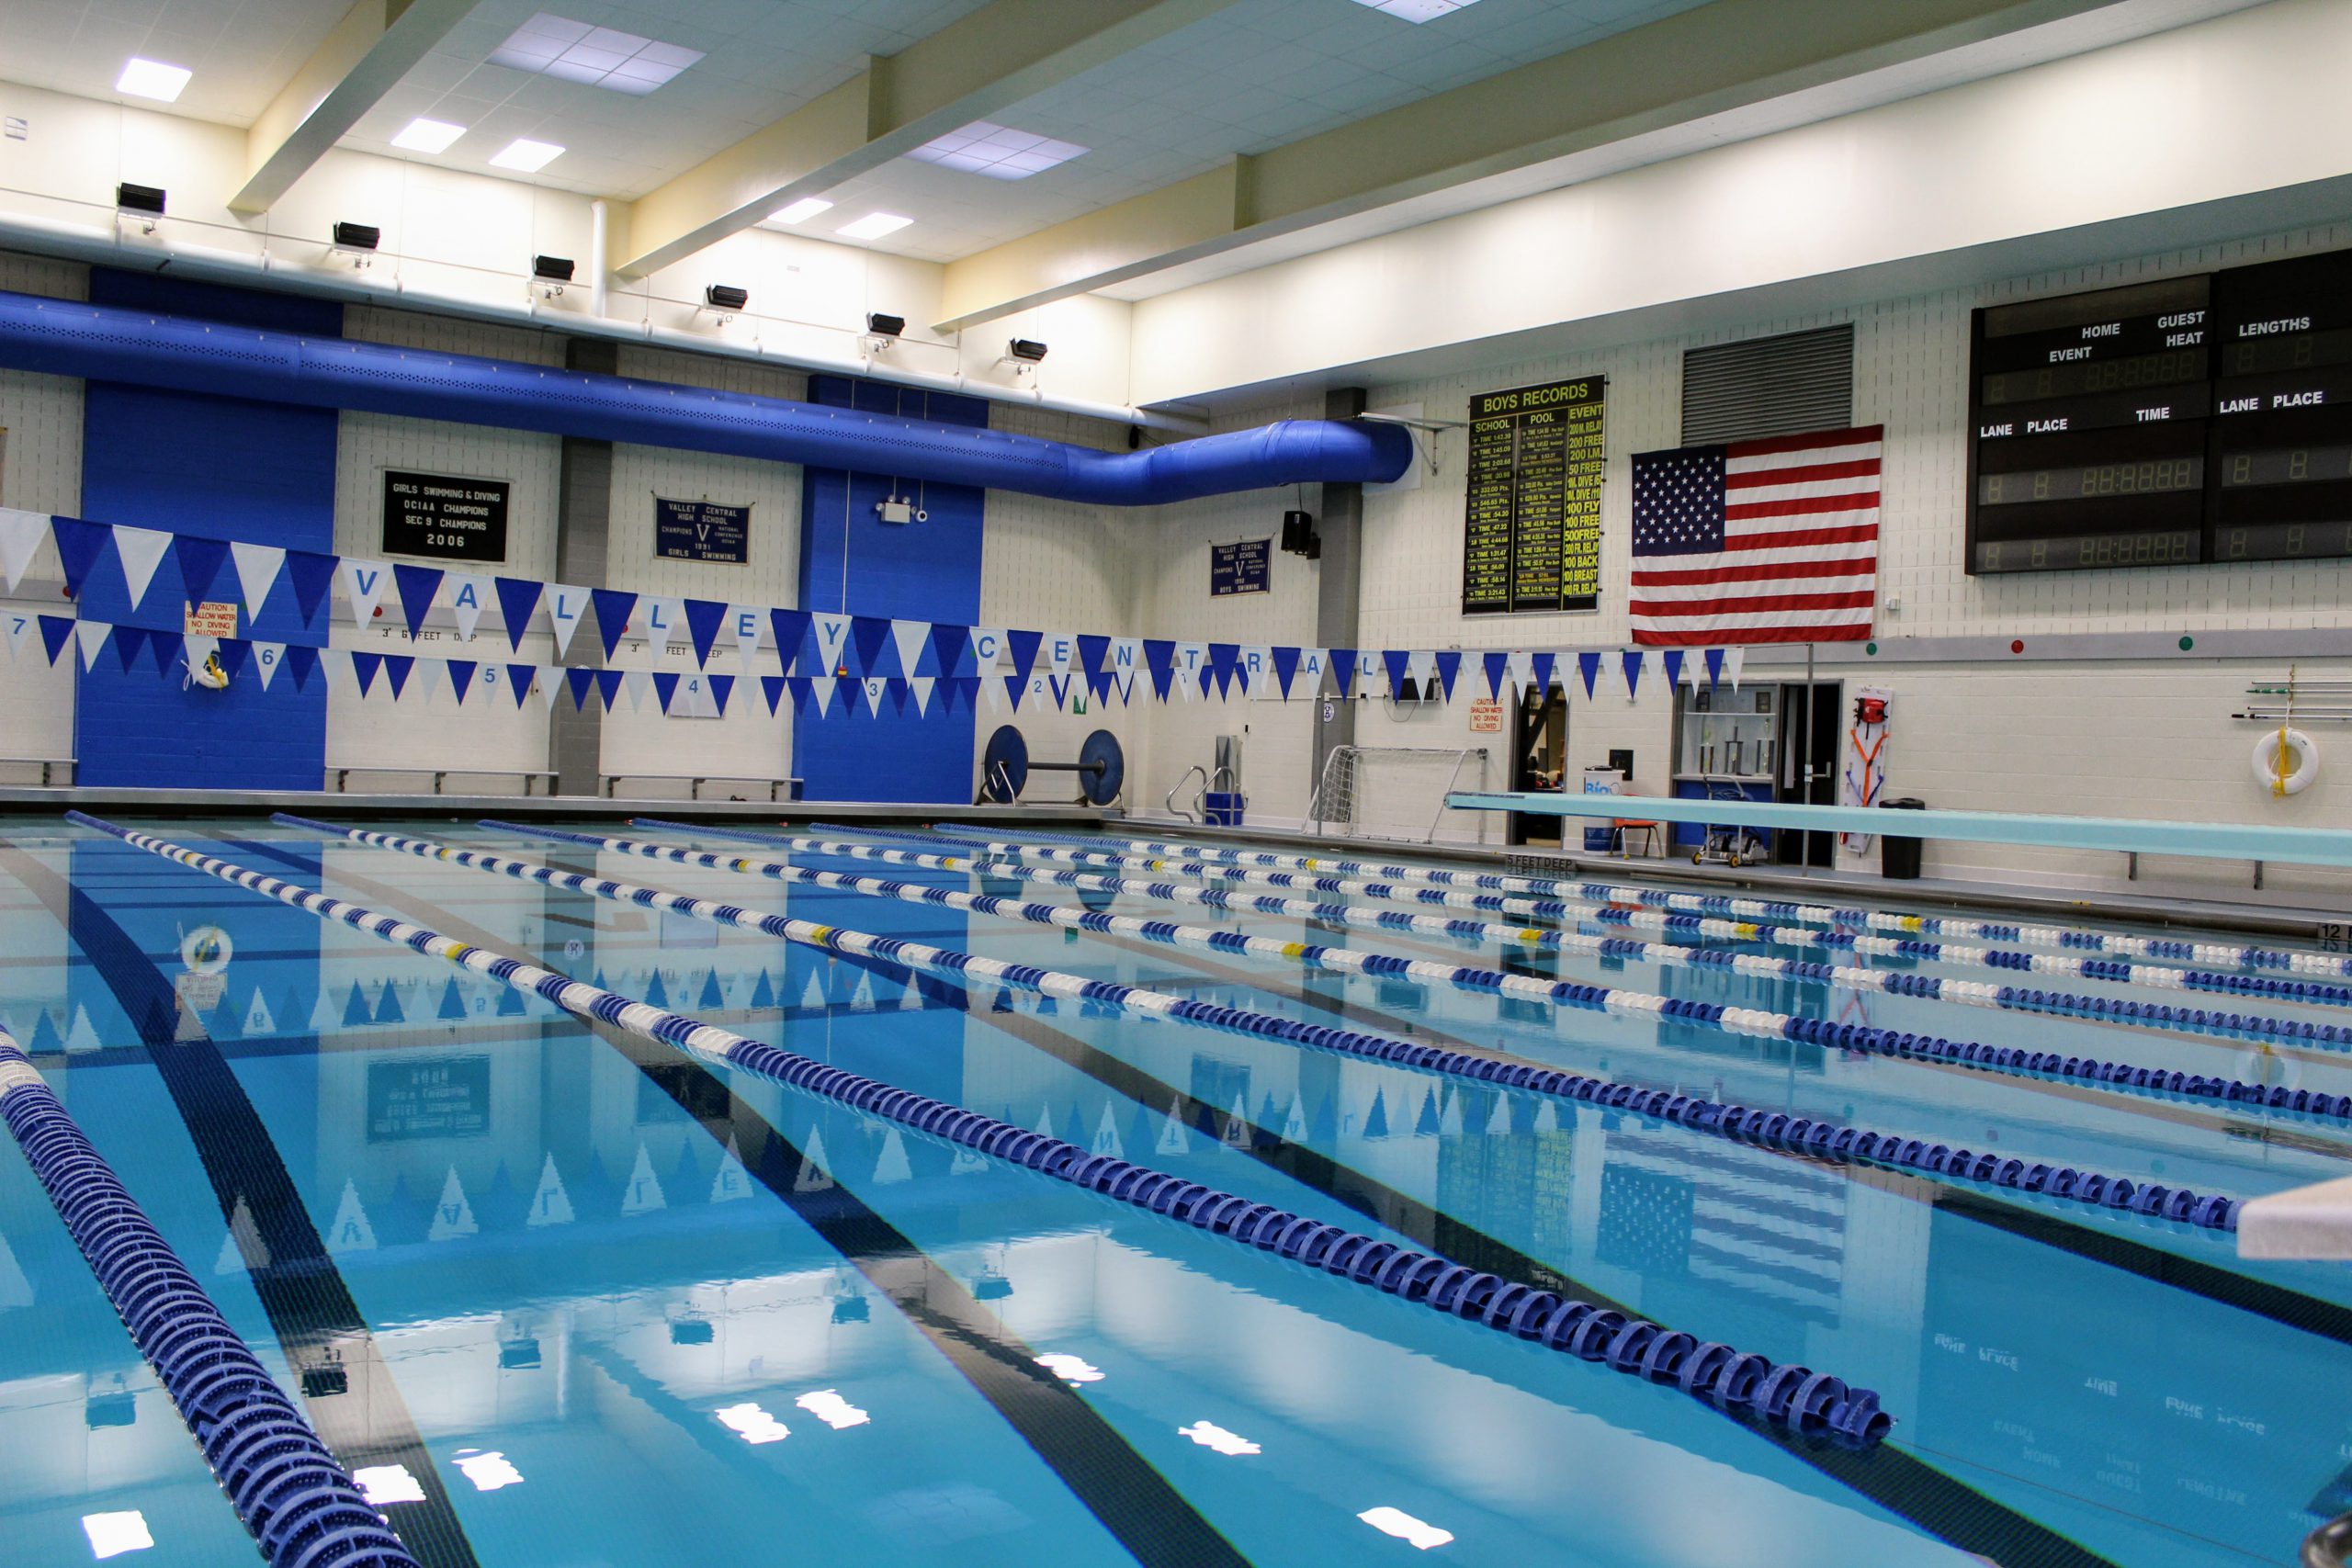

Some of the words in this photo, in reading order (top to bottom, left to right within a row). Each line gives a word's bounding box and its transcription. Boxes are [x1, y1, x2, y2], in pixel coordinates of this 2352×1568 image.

[2082, 323, 2120, 339] HOME
[2157, 310, 2205, 329] GUEST
[2239, 317, 2311, 337] LENGTHS
[2049, 346, 2092, 363] EVENT
[2166, 332, 2203, 347] HEAT
[1484, 394, 1518, 412] BOYS
[1523, 383, 1588, 406] RECORDS
[2220, 398, 2259, 413] LANE
[2273, 391, 2324, 408] PLACE
[1531, 412, 1555, 424] POOL
[1569, 404, 1603, 419] EVENT
[1476, 419, 1510, 433] SCHOOL
[1586, 419, 1602, 432] RELAY
[1981, 424, 2013, 438] LANE
[2027, 419, 2067, 433] PLACE
[2136, 407, 2170, 422] TIME
[1569, 437, 1582, 448] 200
[1584, 434, 1603, 447] FREE
[1570, 450, 1586, 461] 200
[1568, 464, 1578, 475] 50
[1580, 461, 1601, 473] FREE
[1577, 476, 1593, 486] DIVE
[393, 483, 418, 494] GIRLS
[424, 486, 463, 499] SWIMMING
[466, 491, 472, 500] &
[474, 491, 501, 502] DIVING
[1576, 489, 1590, 500] DIVE
[404, 500, 435, 511] OCIAA
[444, 503, 489, 516] CHAMPIONS
[669, 503, 695, 513] VALLEY
[706, 506, 737, 517] CENTRAL
[1566, 503, 1582, 514] 100
[1583, 501, 1600, 513] FLY
[405, 515, 423, 525] SEC
[425, 516, 433, 526] 9
[439, 518, 487, 531] CHAMPIONS
[702, 515, 728, 525] SCHOOL
[1566, 517, 1578, 528] 100
[1579, 514, 1600, 526] FREE
[662, 526, 693, 536] CHAMPIONS
[696, 524, 710, 542] V
[427, 534, 464, 547] 2006
[668, 548, 689, 557] GIRLS
[702, 552, 736, 560] SWIMMING
[1566, 544, 1574, 555] 200
[1583, 542, 1599, 553] RELAY
[1235, 560, 1245, 576] V
[1564, 558, 1577, 568] 100
[1577, 555, 1598, 567] BACK
[1564, 571, 1574, 581] 100
[1574, 570, 1597, 581] BREAST
[1564, 585, 1573, 596] 400
[1580, 582, 1597, 594] RELAY
[201, 604, 228, 612] AUTION
[13, 618, 26, 634] 7
[208, 621, 230, 629] DIVING
[195, 629, 227, 637] ALLOWED
[417, 630, 441, 641] FEET
[262, 649, 274, 665] 6
[666, 647, 687, 656] FEET
[707, 649, 722, 658] EEP
[484, 668, 495, 682] 5
[689, 680, 699, 694] 4
[869, 683, 877, 696] 3
[1035, 681, 1042, 694] 2
[1507, 854, 1514, 864] 5
[1516, 855, 1543, 866] FEET
[1544, 858, 1572, 869] DEEP
[2322, 924, 2340, 938] 12
